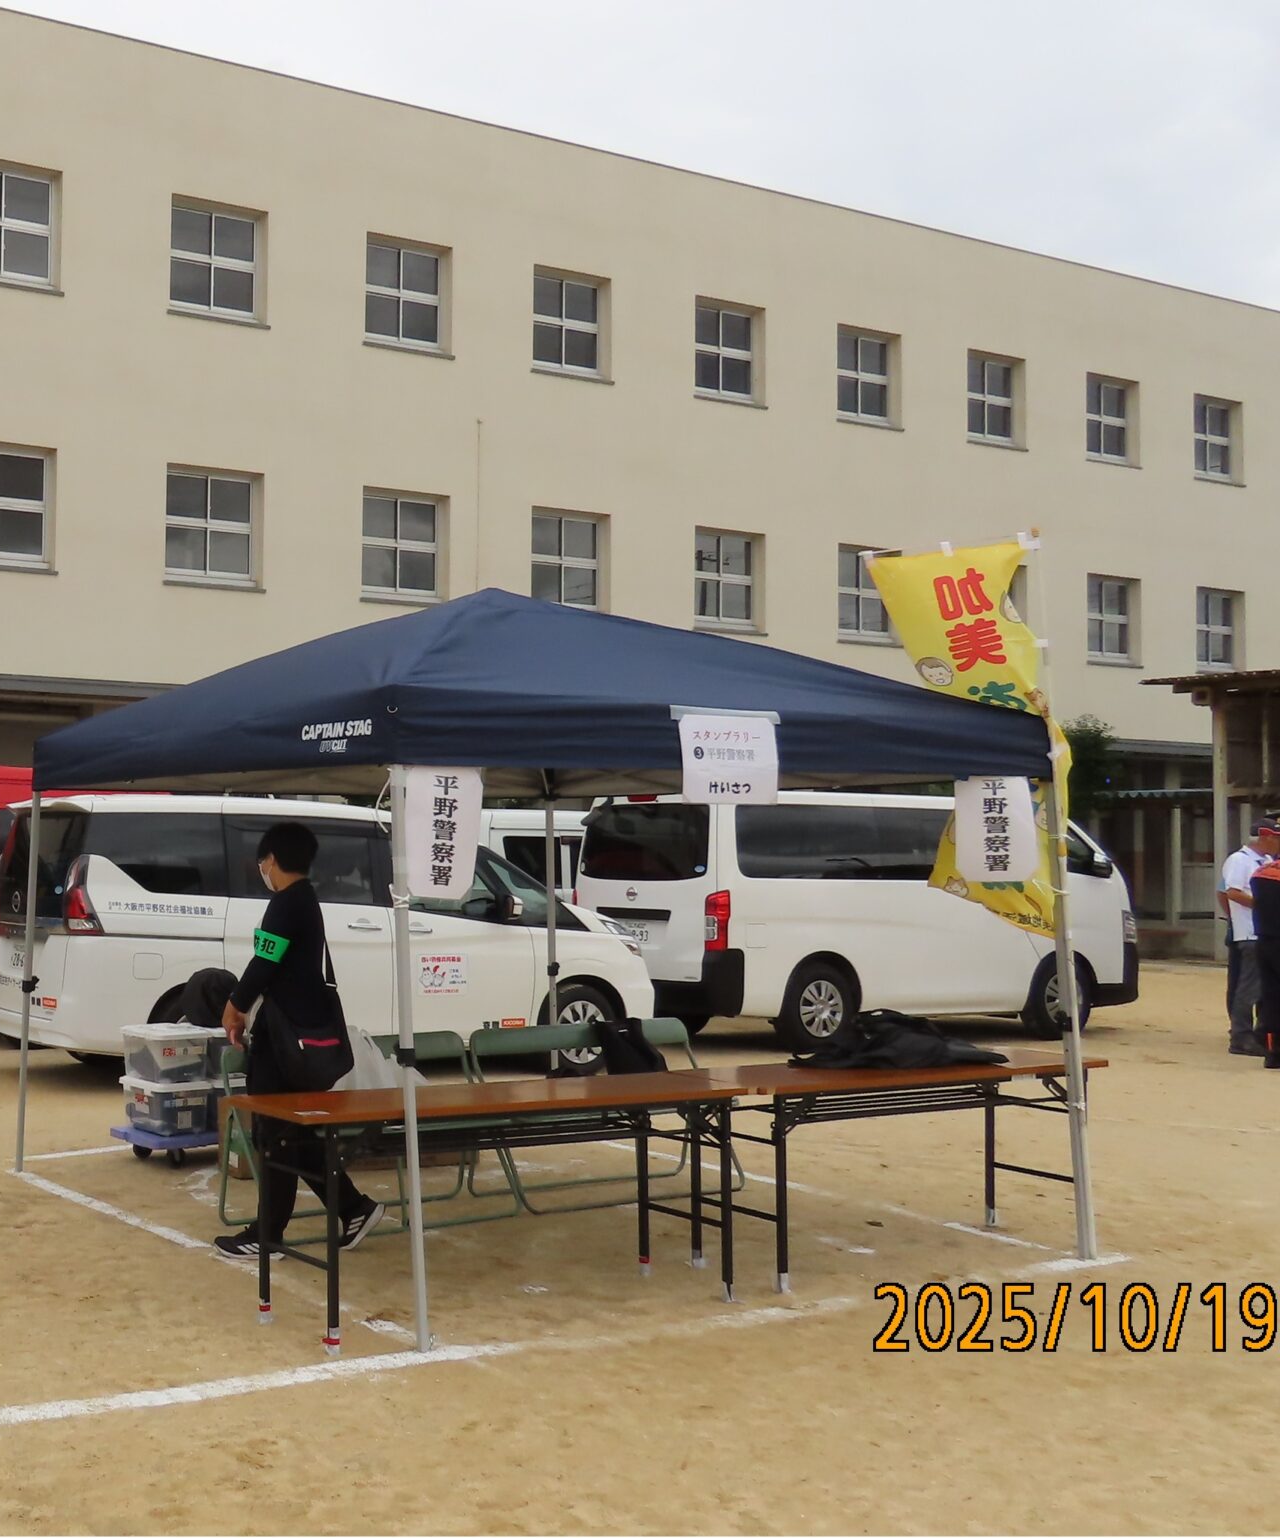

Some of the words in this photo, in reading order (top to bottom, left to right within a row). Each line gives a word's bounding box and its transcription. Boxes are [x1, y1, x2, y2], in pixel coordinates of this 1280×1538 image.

[301, 721, 345, 741] CAPTAIN
[344, 718, 372, 736] STAG
[692, 729, 761, 743] スタンプラリー
[706, 747, 756, 761] 平野警察署
[708, 781, 752, 794] けいさつ
[428, 775, 460, 887] 平野警察署
[982, 779, 1010, 873] 平野警察署
